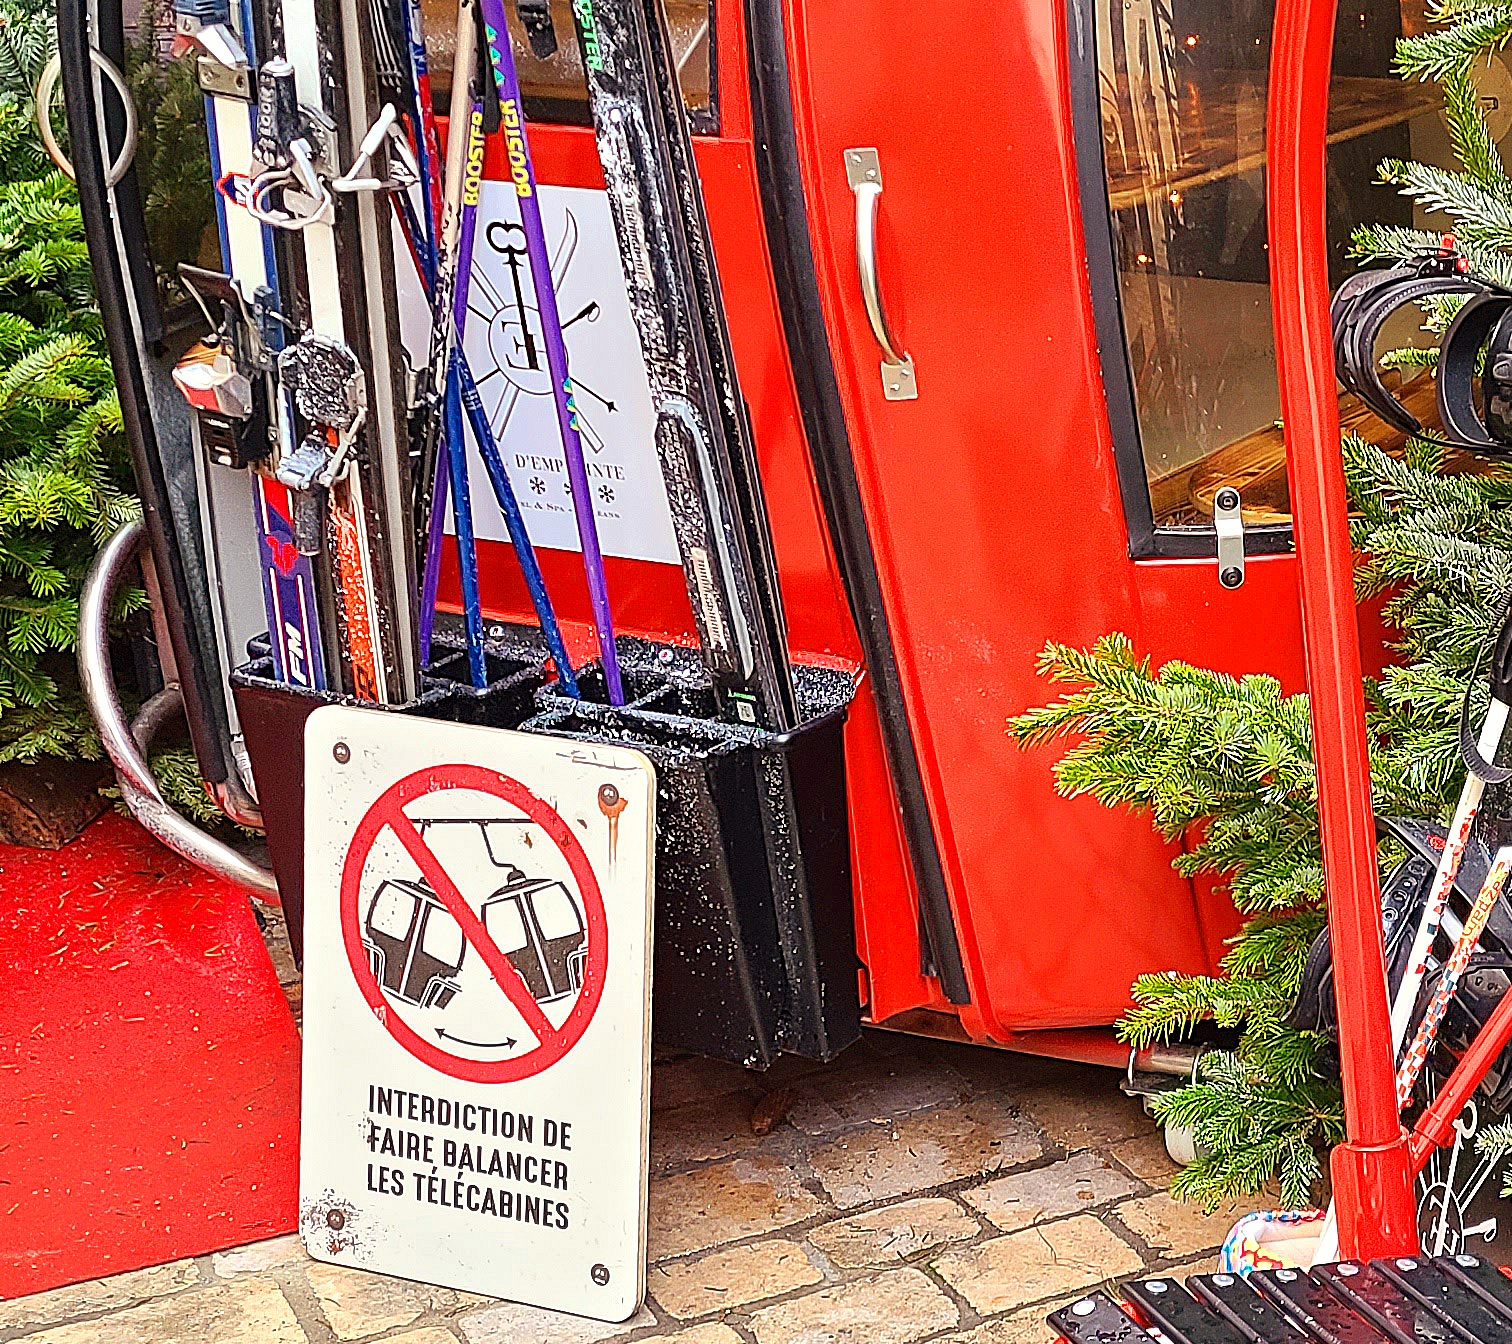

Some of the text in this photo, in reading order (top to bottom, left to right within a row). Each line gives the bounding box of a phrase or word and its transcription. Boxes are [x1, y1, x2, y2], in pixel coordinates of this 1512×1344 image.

[499, 98, 533, 198] BOOSTER
[515, 453, 626, 481] D'EMPINTE
[368, 1084, 572, 1151] INTERDICTION DE
[369, 1123, 568, 1191] FAIRE BALANCER
[367, 1163, 570, 1231] LES TÉLÉCABINES
